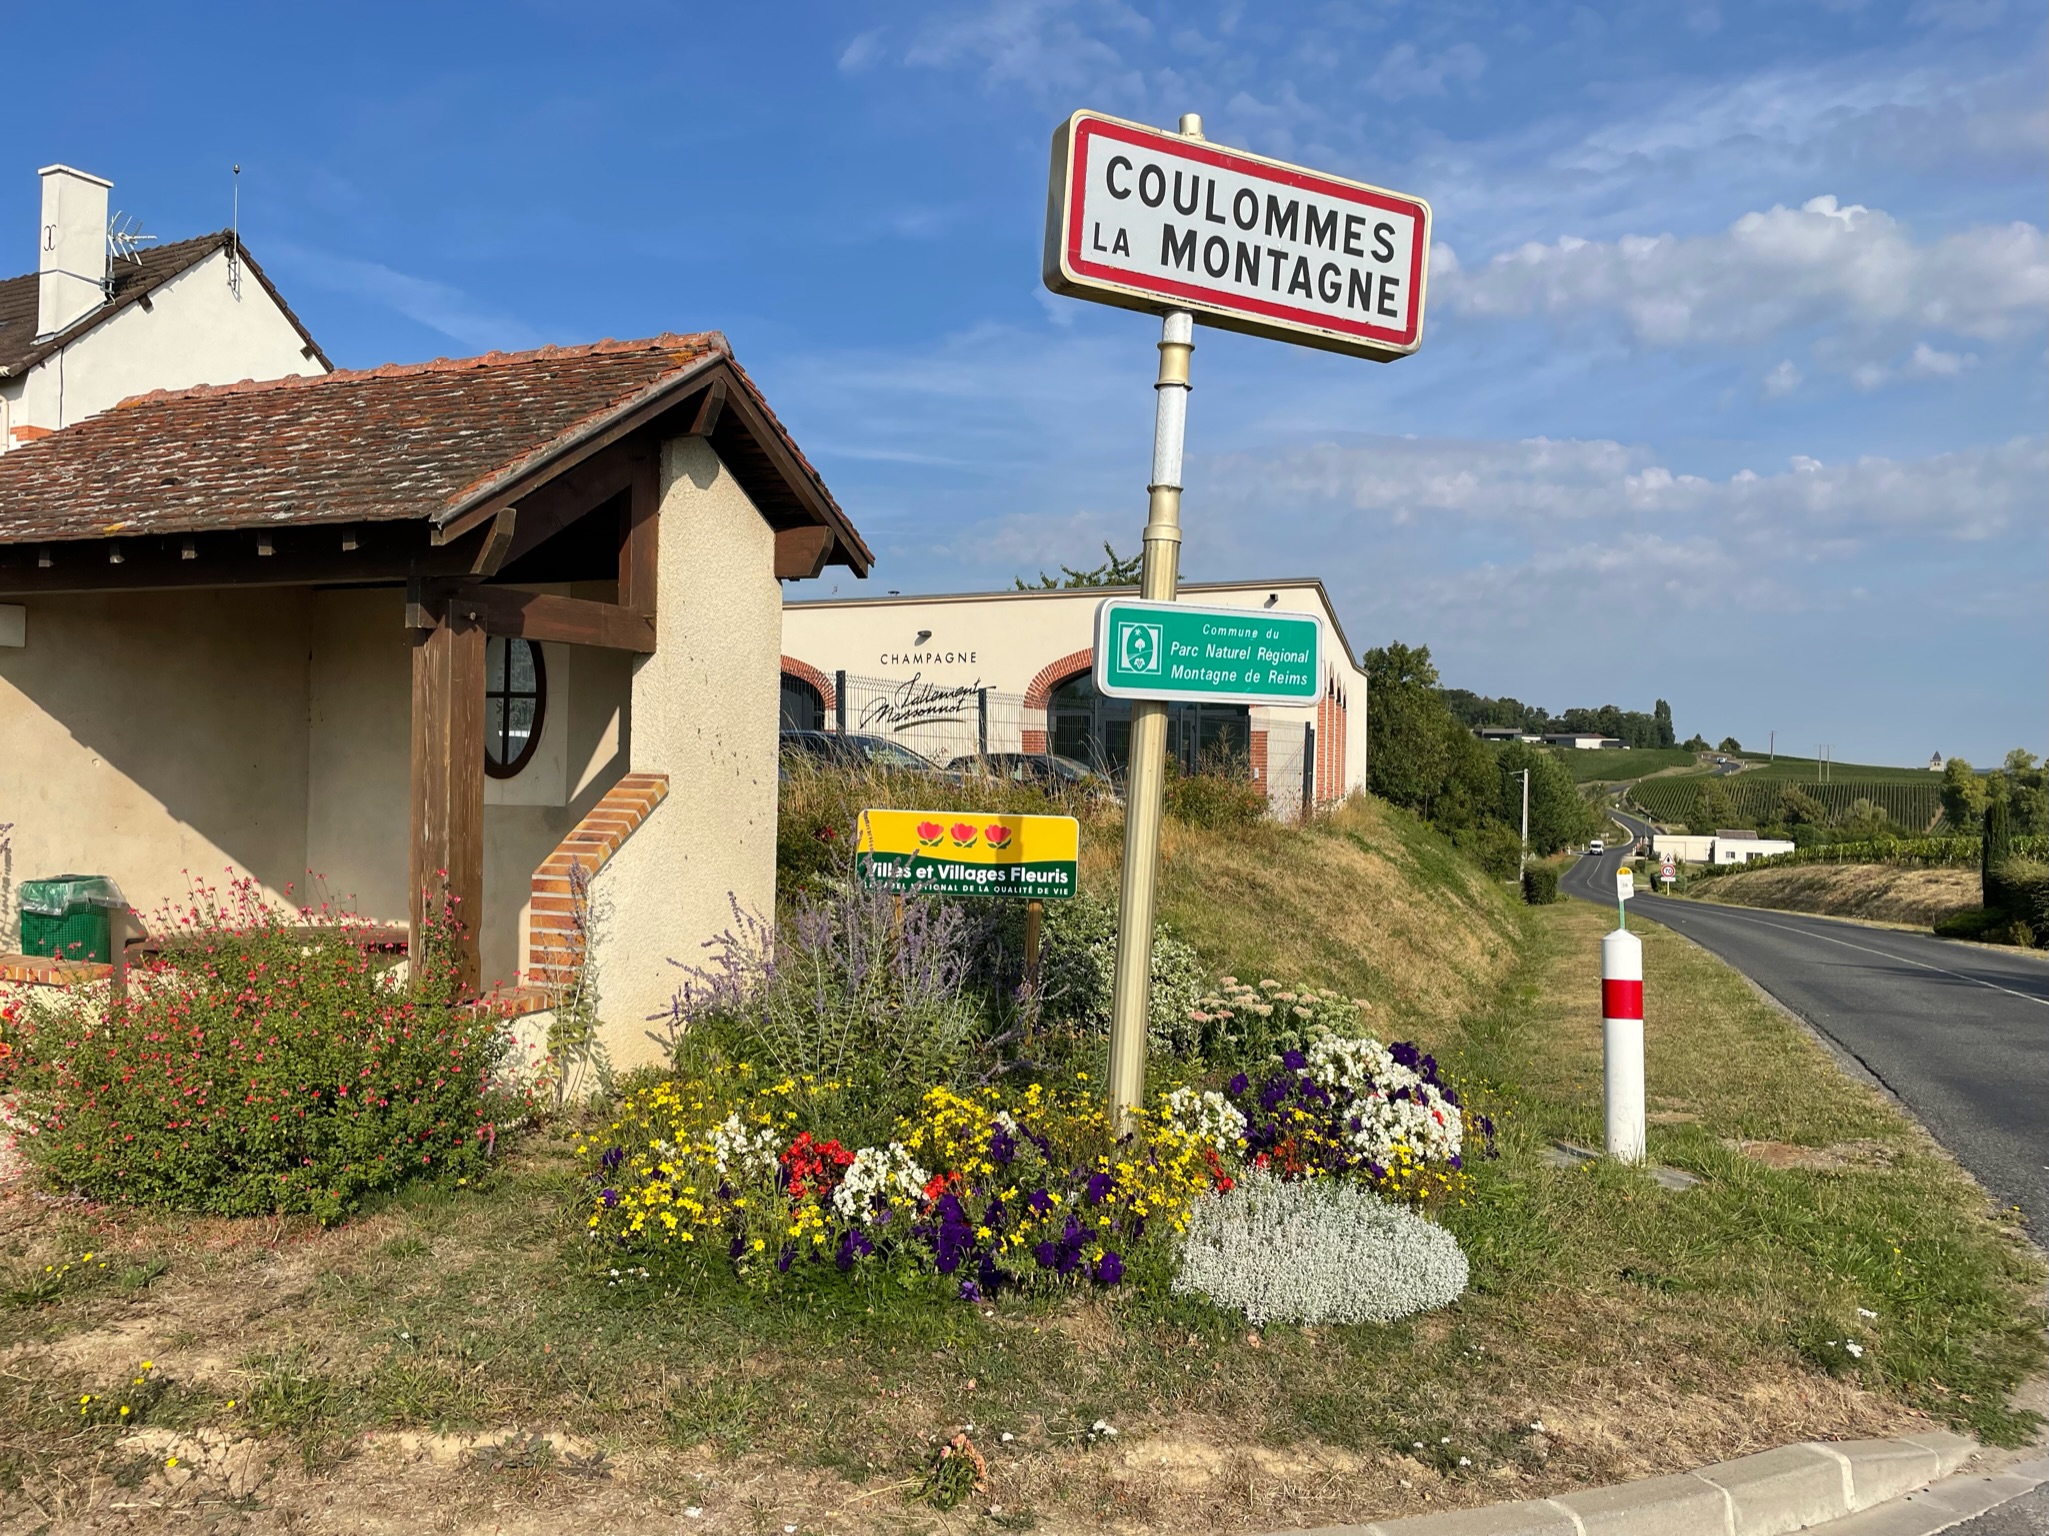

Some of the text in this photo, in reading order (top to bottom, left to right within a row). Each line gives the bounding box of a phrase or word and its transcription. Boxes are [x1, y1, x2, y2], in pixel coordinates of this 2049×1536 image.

[1106, 155, 1396, 264] COULOMMES
[1093, 222, 1400, 318] LA MONTAGNE
[1202, 623, 1280, 640] Commune du
[880, 651, 977, 665] CHAMPAGNE
[1170, 641, 1309, 667] Parc Naturel Régional
[1170, 664, 1308, 686] Montagne de Reims
[916, 864, 934, 879] et
[937, 864, 1006, 885] Villages
[1010, 866, 1069, 884] Fleuris
[962, 884, 975, 893] DE
[978, 885, 990, 893] LA
[994, 885, 1033, 894] QUALITÉ
[1037, 886, 1049, 895] DE
[1053, 887, 1069, 896] VIE
